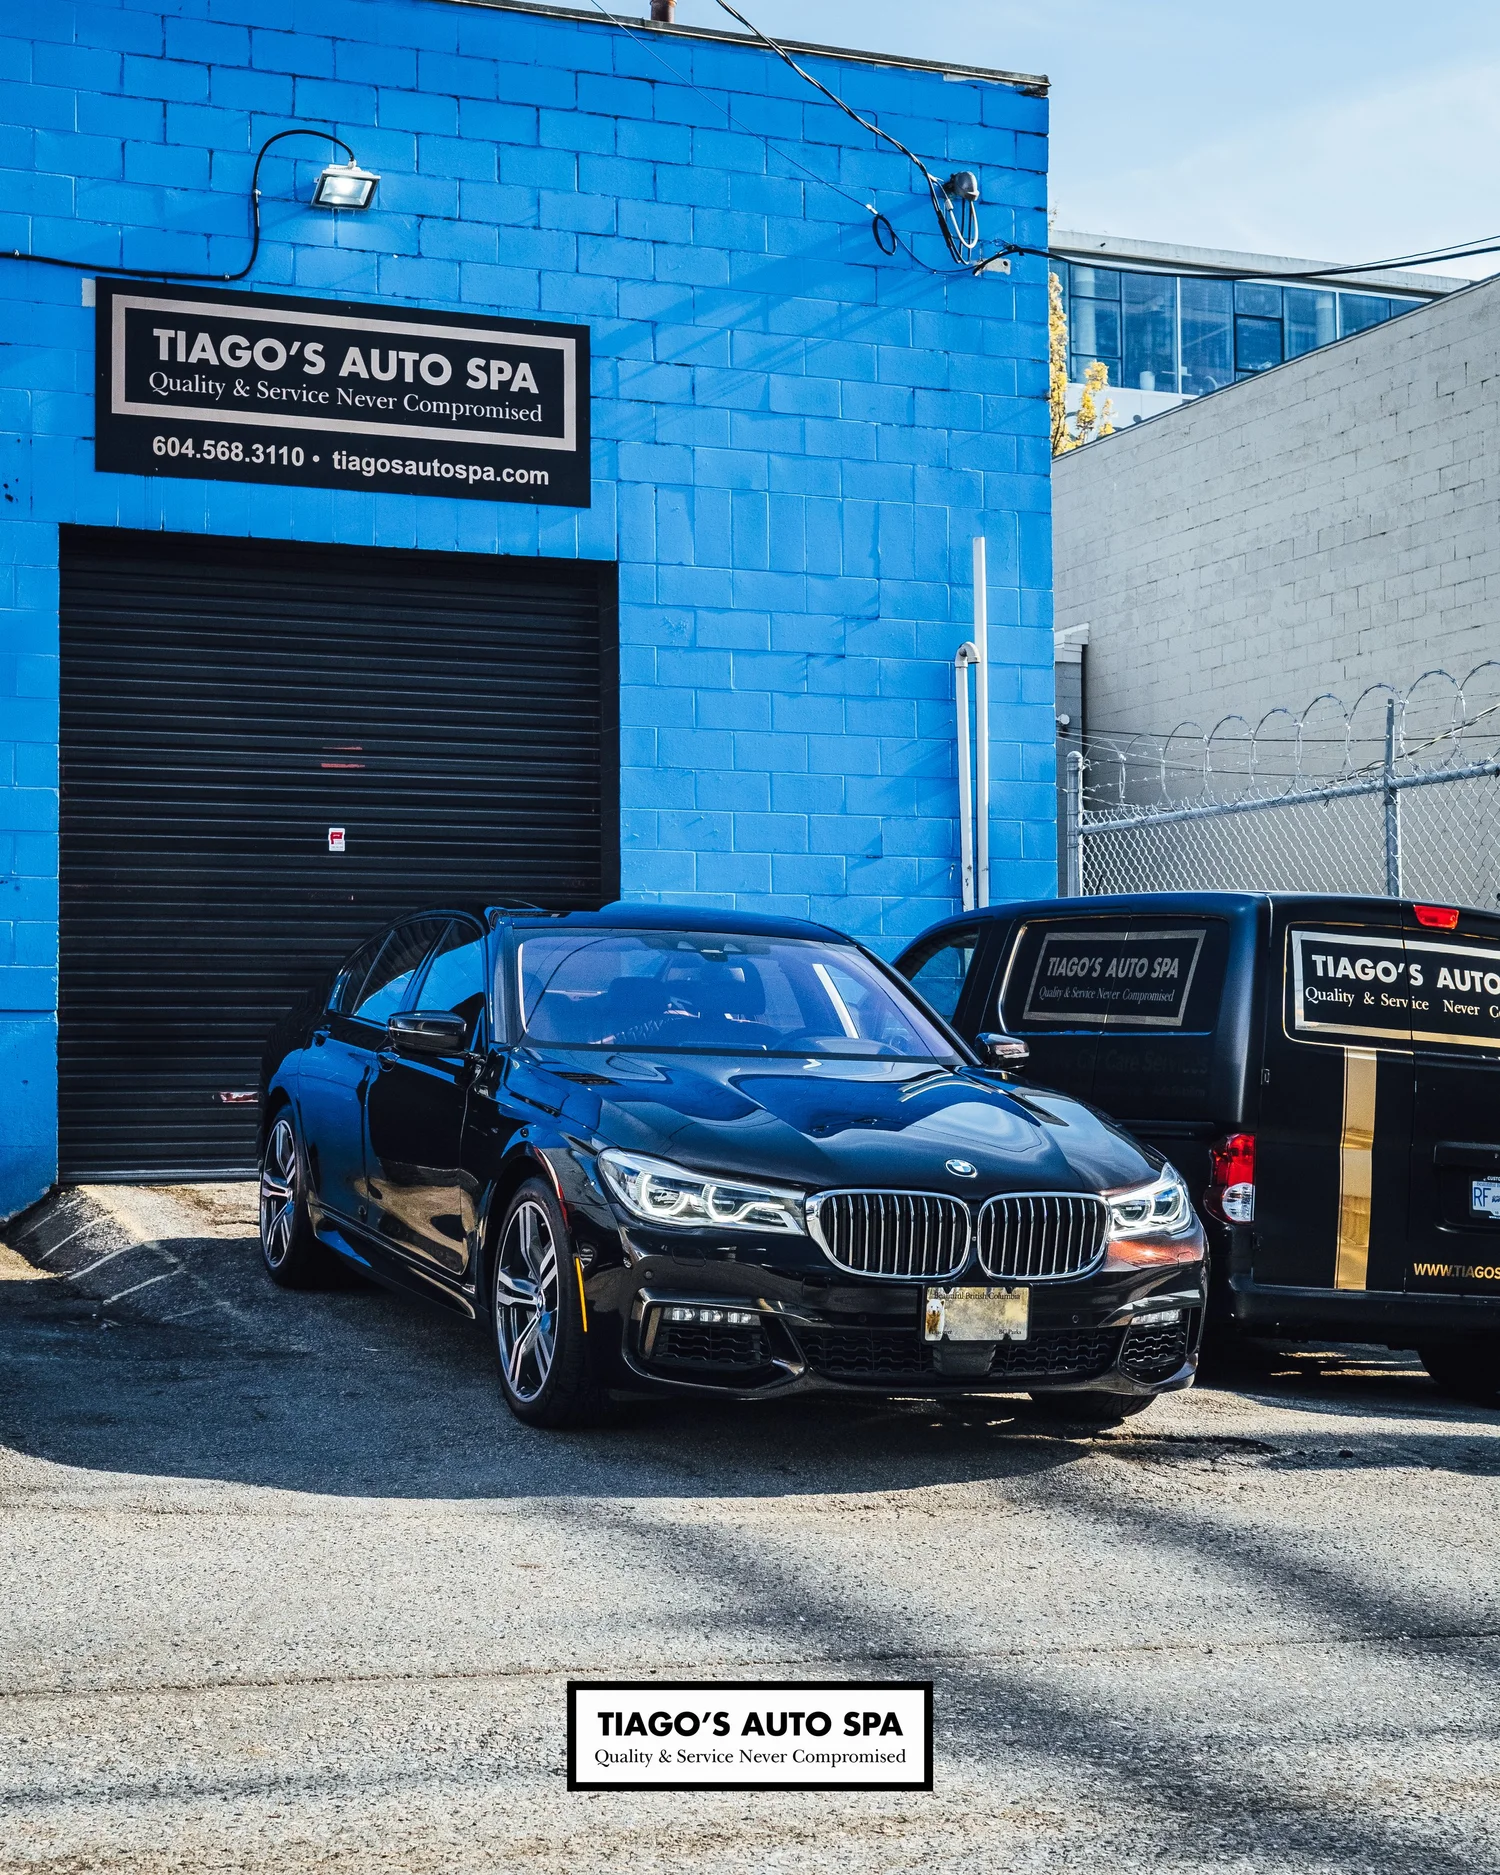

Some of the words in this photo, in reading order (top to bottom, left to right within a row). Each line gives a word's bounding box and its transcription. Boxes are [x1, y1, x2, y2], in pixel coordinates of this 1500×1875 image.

[153, 329, 326, 373] TIAGO'S
[339, 347, 452, 385] AUTO
[466, 358, 539, 393] SPA
[149, 372, 225, 400] Quality
[233, 379, 249, 397] &
[257, 381, 329, 403] Service
[337, 388, 397, 409] Never
[404, 392, 542, 422] Compromised
[153, 436, 304, 466] 604.568.3110
[332, 451, 549, 485] tiagosautospa.com
[1047, 957, 1103, 977] TIAGO'S
[1105, 958, 1148, 978] AUTO
[1151, 957, 1179, 978] SPA
[1311, 954, 1423, 986] TIAGO'S
[1437, 967, 1500, 995] AUTO
[1039, 986, 1063, 1000] Quality
[1064, 987, 1070, 997] &
[1072, 987, 1096, 998] Service
[1097, 988, 1120, 999] Never
[1123, 988, 1175, 1004] Compromised
[1305, 987, 1354, 1007] Quality
[1364, 992, 1374, 1004] &
[1381, 993, 1429, 1010] Service
[1443, 1000, 1480, 1015] Never
[1489, 1005, 1500, 1018] C
